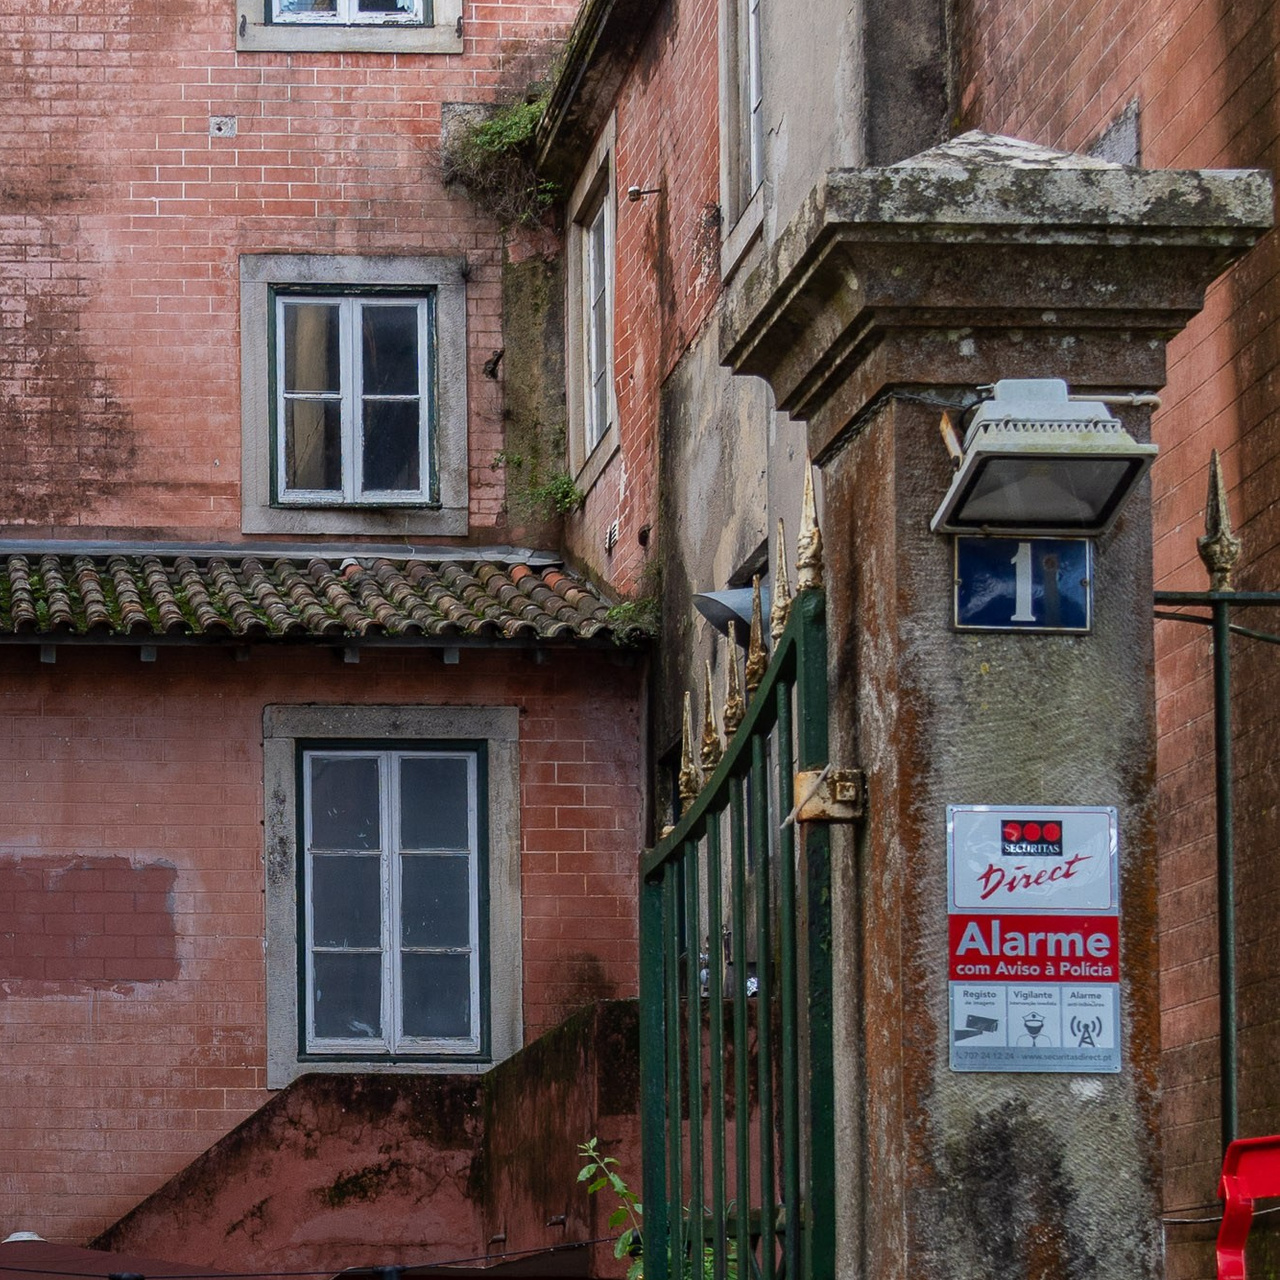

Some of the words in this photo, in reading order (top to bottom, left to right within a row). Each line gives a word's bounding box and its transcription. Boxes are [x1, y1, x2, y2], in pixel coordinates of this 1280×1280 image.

[1010, 542, 1037, 622] 1
[1003, 843, 1061, 854] SECURITAS
[976, 853, 1094, 900] Direct
[955, 919, 1111, 958] Alarme
[955, 963, 991, 975] com
[995, 961, 1041, 976] Aviso
[1044, 962, 1056, 976] à
[1059, 961, 1113, 977] Polícia
[962, 990, 998, 1001] Registo
[1013, 991, 1054, 1001] Vigilante
[1069, 991, 1102, 1000] Alarme
[963, 1051, 980, 1060] 707
